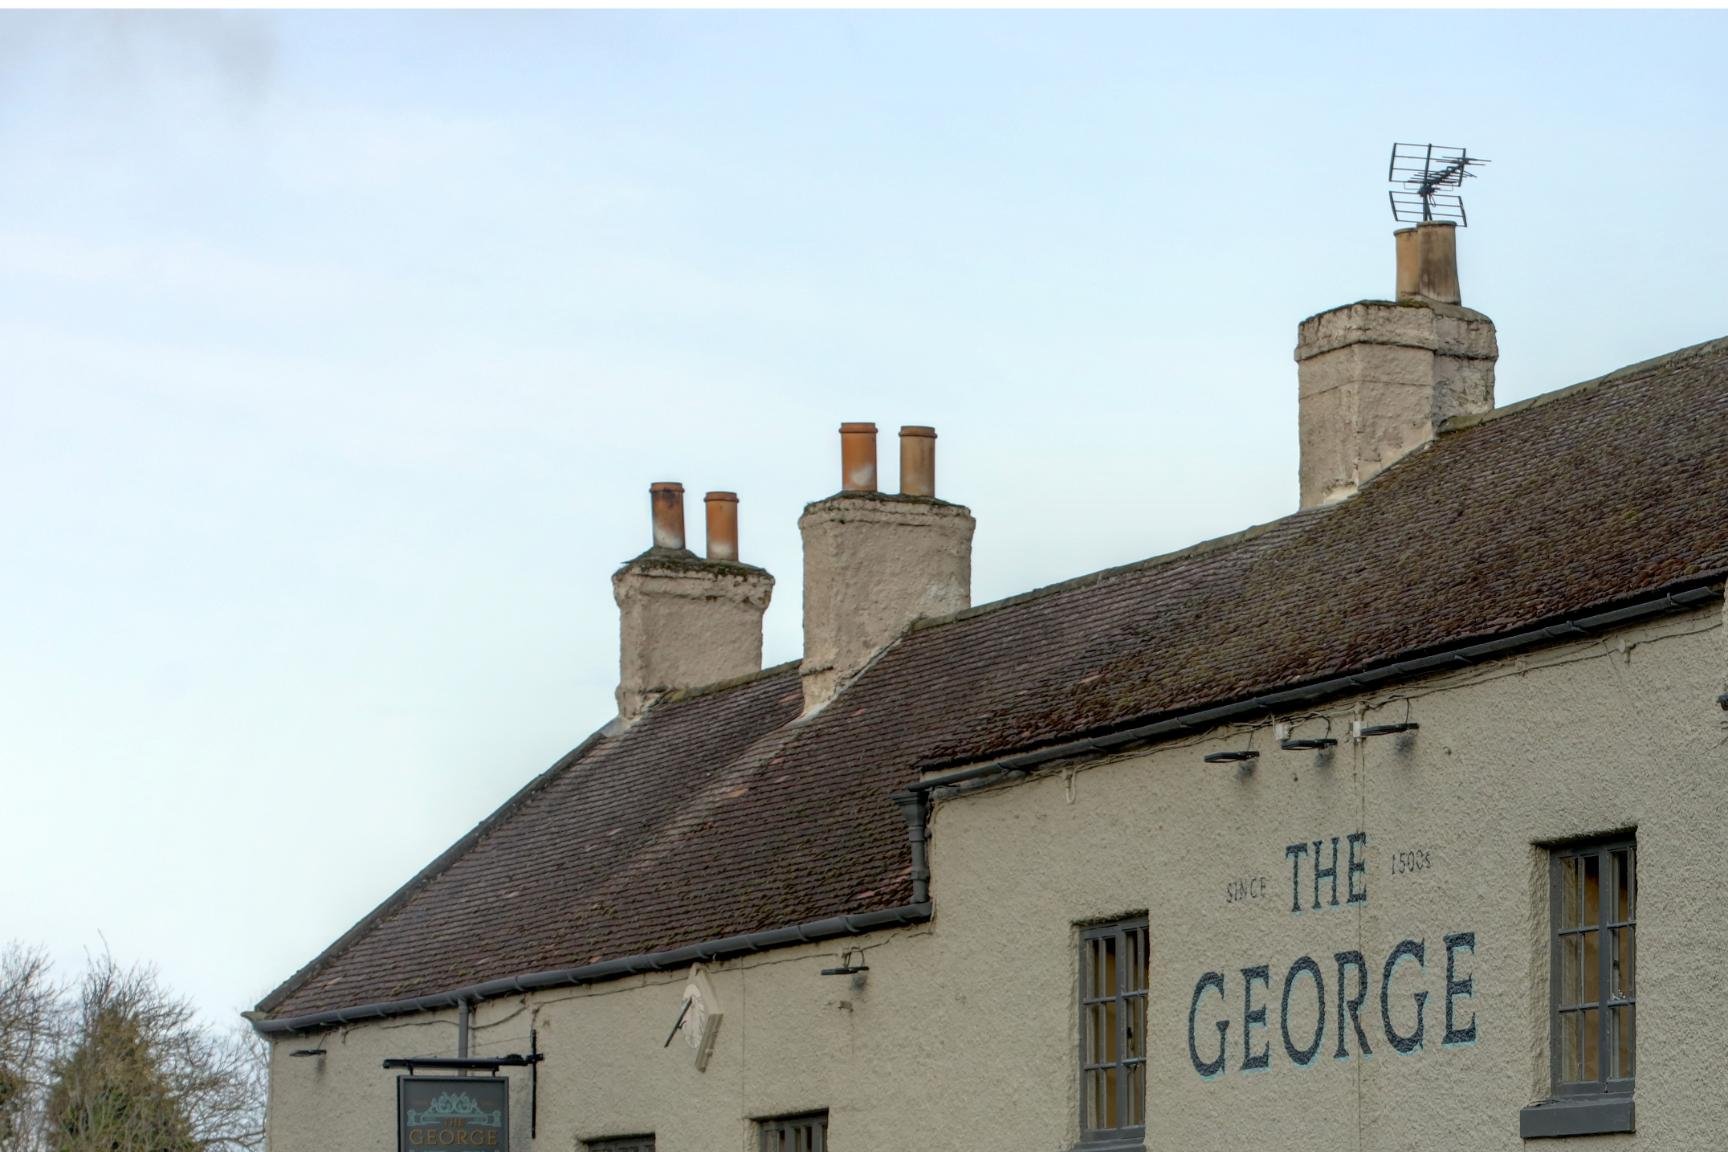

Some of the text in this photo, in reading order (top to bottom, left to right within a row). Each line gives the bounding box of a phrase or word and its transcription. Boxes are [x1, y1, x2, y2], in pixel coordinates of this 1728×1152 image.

[1226, 877, 1267, 903] SINCE
[1285, 831, 1367, 913] THE
[1188, 932, 1477, 1080] GEORGE
[409, 1128, 498, 1146] GEORGE
